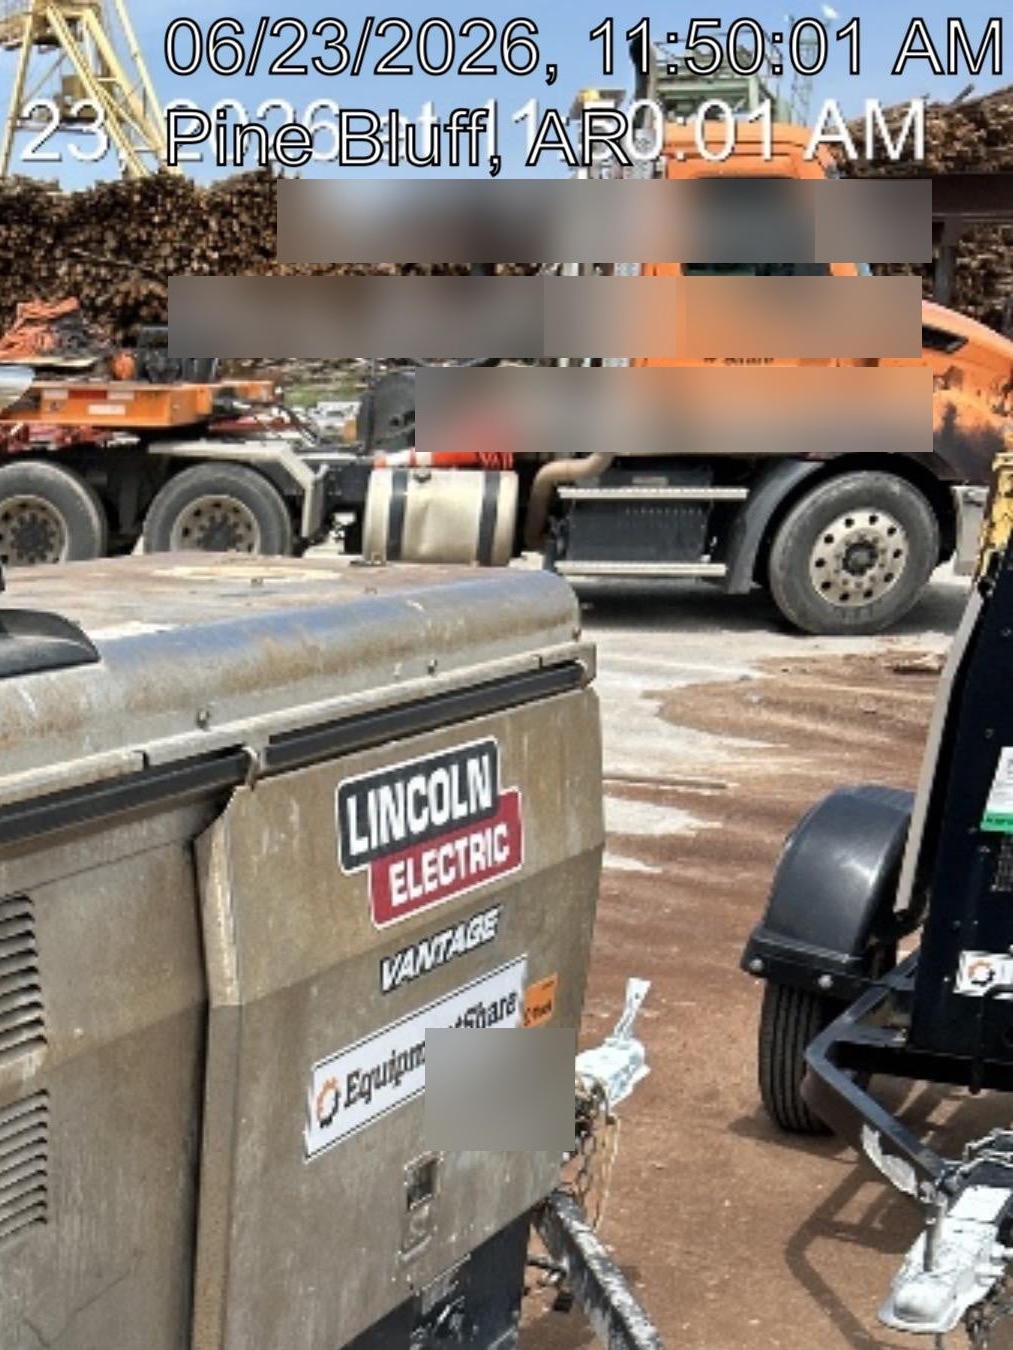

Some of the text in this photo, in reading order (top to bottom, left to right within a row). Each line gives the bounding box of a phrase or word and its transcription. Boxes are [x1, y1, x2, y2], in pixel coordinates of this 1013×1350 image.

[346, 753, 493, 857] LINCOLN
[389, 821, 511, 908] ELECTRIC
[380, 902, 503, 994] VANTAGE
[343, 990, 518, 1109] EquipmtShare
